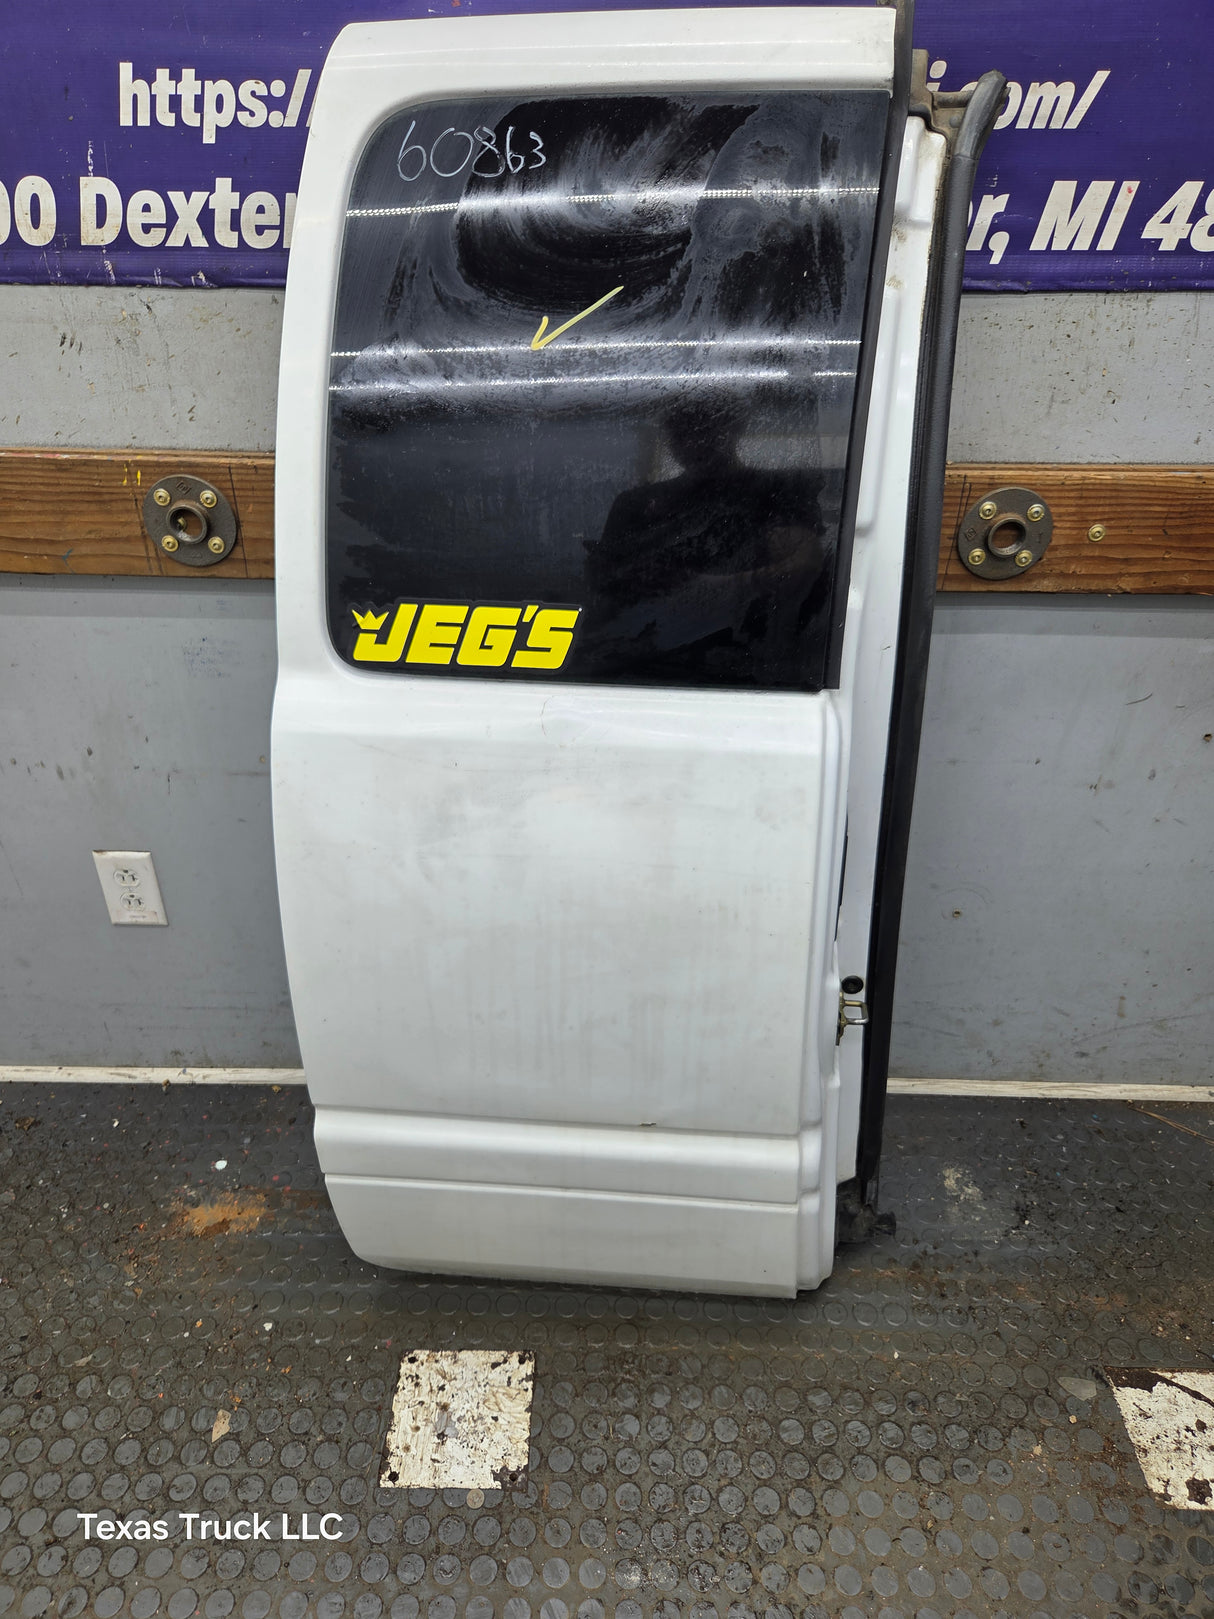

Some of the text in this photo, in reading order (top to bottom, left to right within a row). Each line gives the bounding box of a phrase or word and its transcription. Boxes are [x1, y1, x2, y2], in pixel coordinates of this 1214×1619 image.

[119, 62, 318, 144] https:/
[397, 120, 546, 182] 60863
[0, 175, 57, 247] 0
[964, 193, 1010, 265] r,
[1029, 181, 1141, 251] MI
[353, 603, 580, 669] JEG'S
